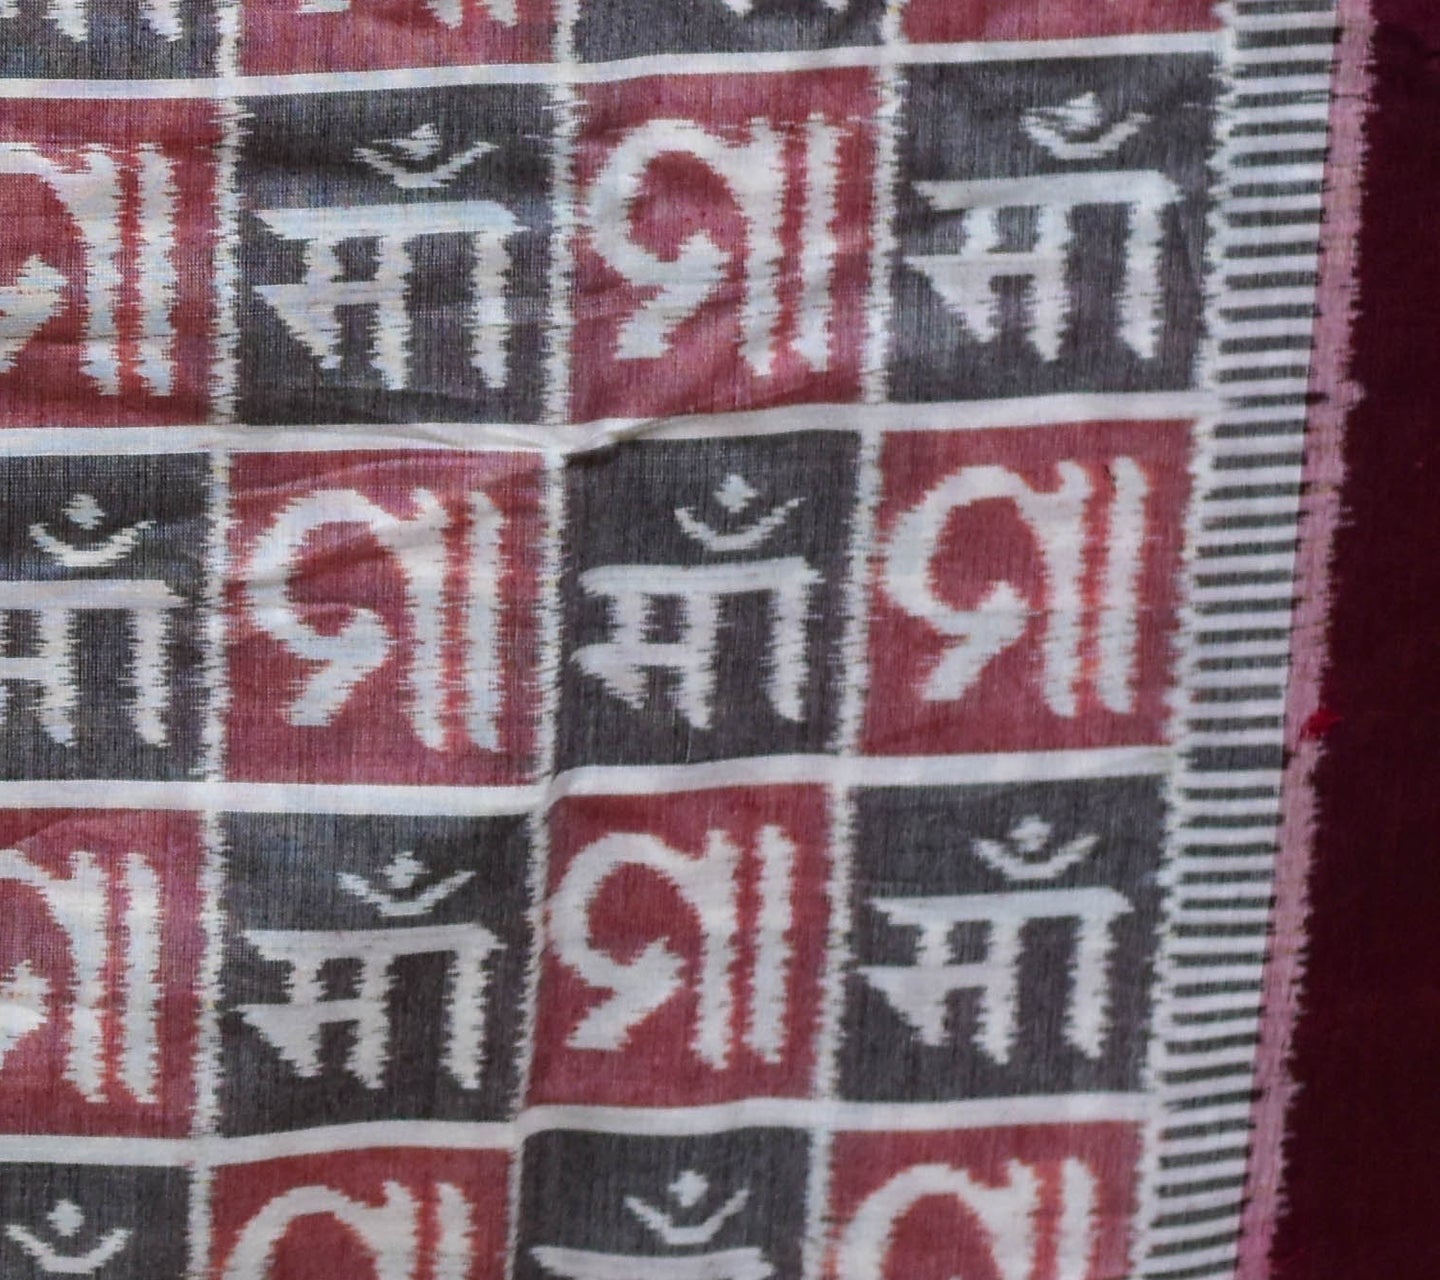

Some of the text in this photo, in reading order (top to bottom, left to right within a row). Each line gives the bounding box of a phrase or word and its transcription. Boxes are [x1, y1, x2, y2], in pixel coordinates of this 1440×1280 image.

[255, 124, 528, 390] माँ
[906, 93, 1181, 360] माँ
[576, 473, 821, 729] माँ
[860, 817, 1130, 1063] माँ
